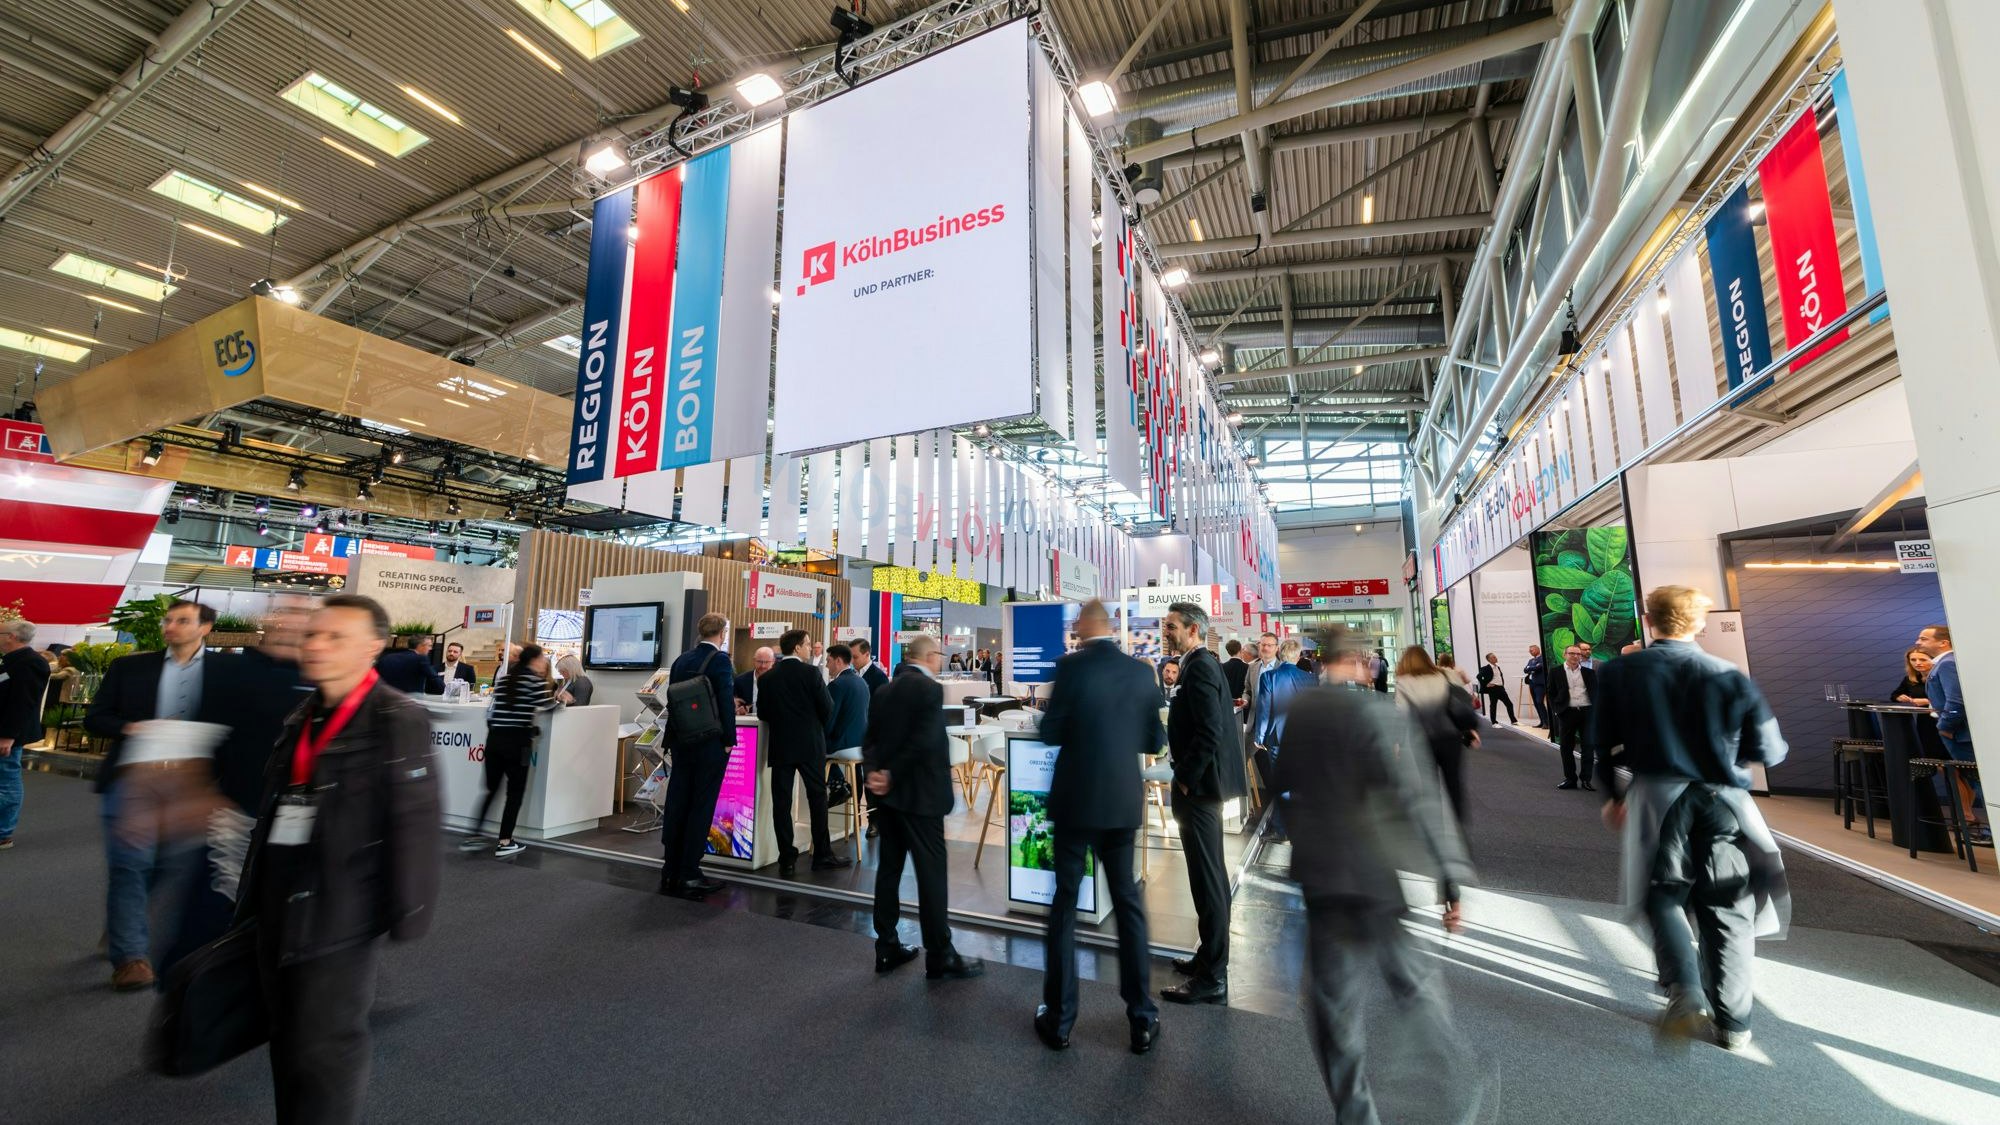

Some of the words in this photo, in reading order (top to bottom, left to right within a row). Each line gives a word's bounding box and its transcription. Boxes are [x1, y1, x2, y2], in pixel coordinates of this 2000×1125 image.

[842, 203, 1005, 267] KölnBusiness
[853, 284, 878, 298] UND
[880, 268, 935, 292] PARTNER:
[1796, 249, 1825, 339] KÖLN
[1728, 277, 1755, 384] REGION
[214, 330, 249, 368] ECE
[576, 319, 609, 471] REGION
[675, 325, 705, 453] BONN
[624, 346, 655, 461] KÖLN
[362, 548, 408, 558] BREMERHAVEN
[363, 542, 390, 550] BREMEN
[1899, 544, 1930, 552] expo
[283, 558, 328, 568] BREMERHAVEN
[378, 570, 426, 582] CREATING
[429, 574, 459, 584] SPACE.
[378, 580, 427, 592] INSPIRING
[429, 584, 465, 594] PEOPLE.
[776, 588, 812, 598] KölnBusiness
[1298, 588, 1311, 596] C2
[1354, 586, 1368, 594] B3
[1148, 594, 1202, 604] BAUWENS
[1481, 590, 1532, 600] Metropol
[430, 731, 472, 748] REGION
